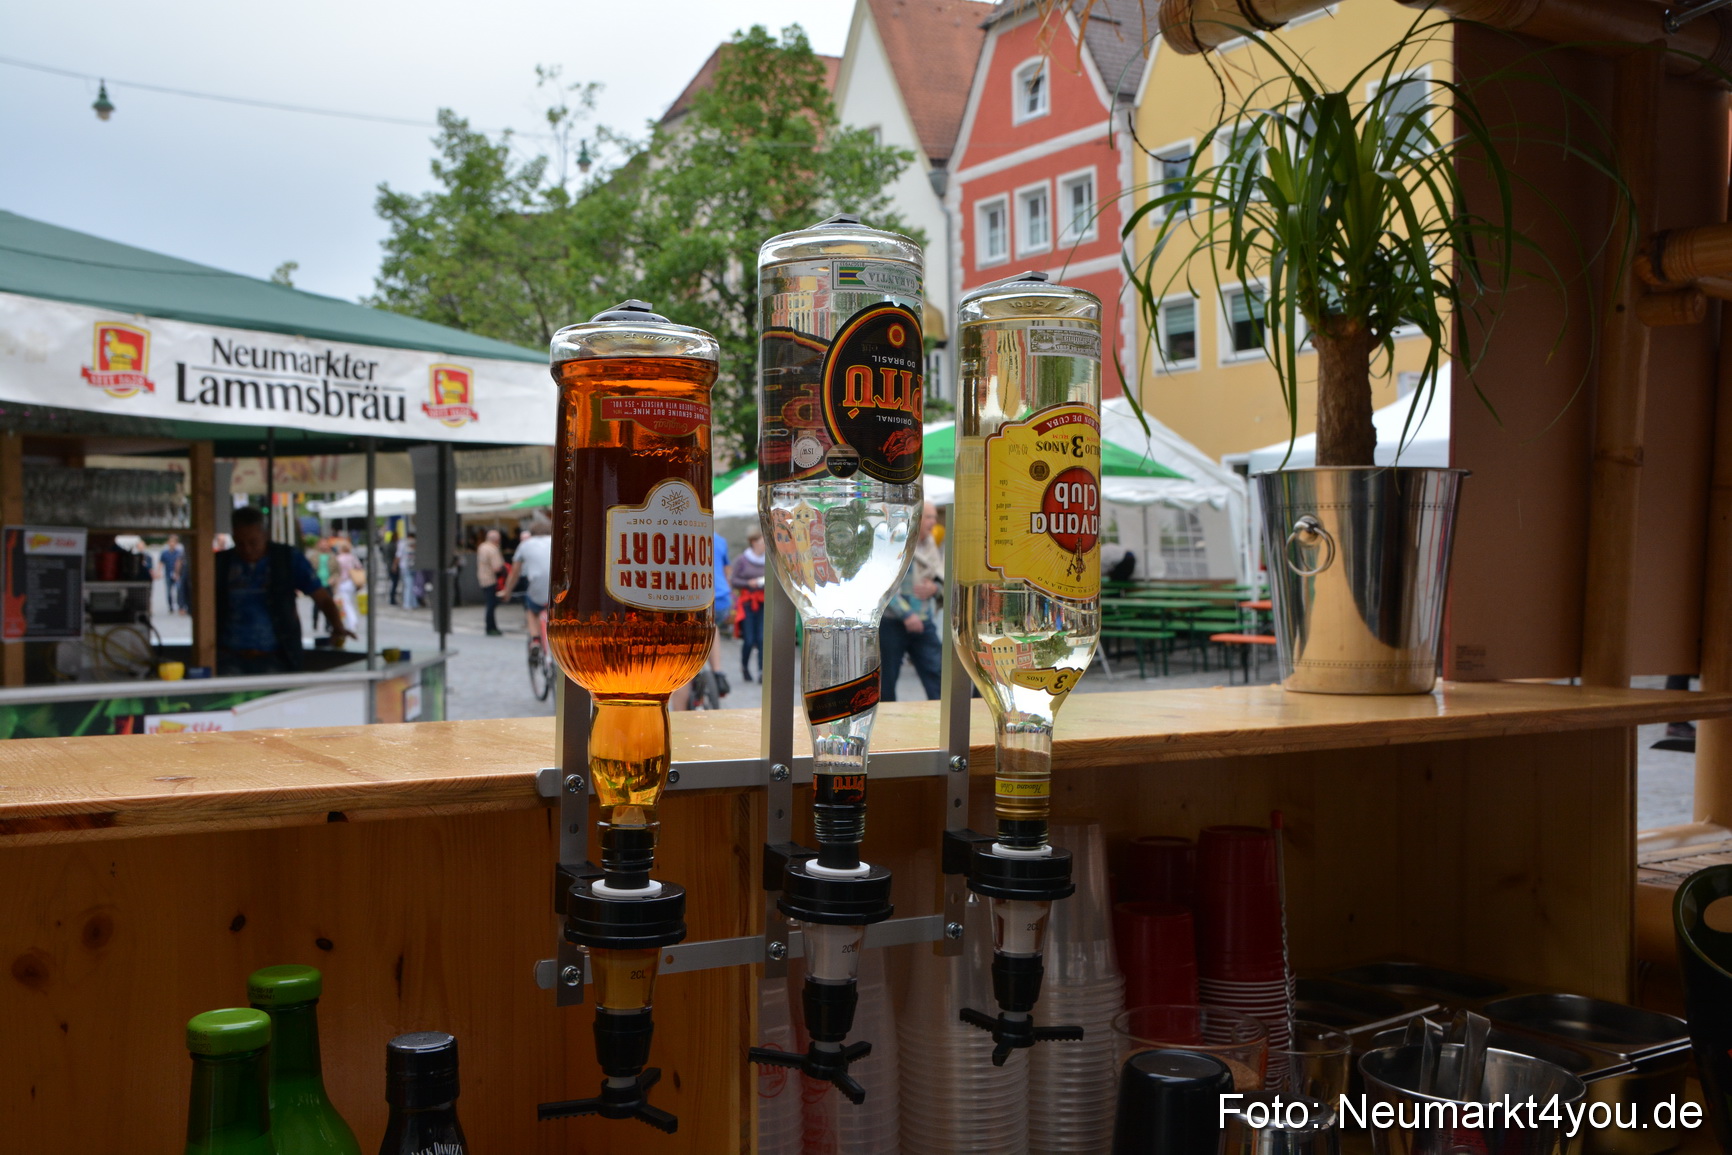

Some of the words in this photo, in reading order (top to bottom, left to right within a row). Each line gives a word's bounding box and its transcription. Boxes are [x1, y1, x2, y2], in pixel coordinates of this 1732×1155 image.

[212, 336, 380, 382] Neumarkter
[871, 354, 905, 366] BRASIL
[906, 359, 916, 369] DO
[176, 361, 406, 423] Lammsbräu
[610, 400, 623, 408] VOL.
[640, 400, 664, 409] WHISKEY
[653, 408, 666, 417] BUT
[667, 409, 693, 419] GENUINE
[1072, 414, 1082, 423] DE
[875, 414, 912, 426] ORIGINAL
[1046, 415, 1070, 429] CUBA
[1035, 440, 1070, 455] AÑOS
[1071, 434, 1084, 459] 3
[1054, 481, 1098, 512] Club
[657, 518, 669, 526] OF
[672, 519, 708, 528] CATEGORY
[1030, 510, 1101, 537] avana
[617, 531, 713, 568] COMFORT
[619, 570, 713, 591] SOUTHERN
[1037, 576, 1074, 593] CUBANO
[647, 593, 686, 601] HERON'S
[1053, 674, 1068, 690] 3
[832, 775, 866, 794] PITÚ
[1016, 784, 1044, 794] Havana
[841, 943, 856, 954] 2CL
[630, 968, 647, 980] 2CL
